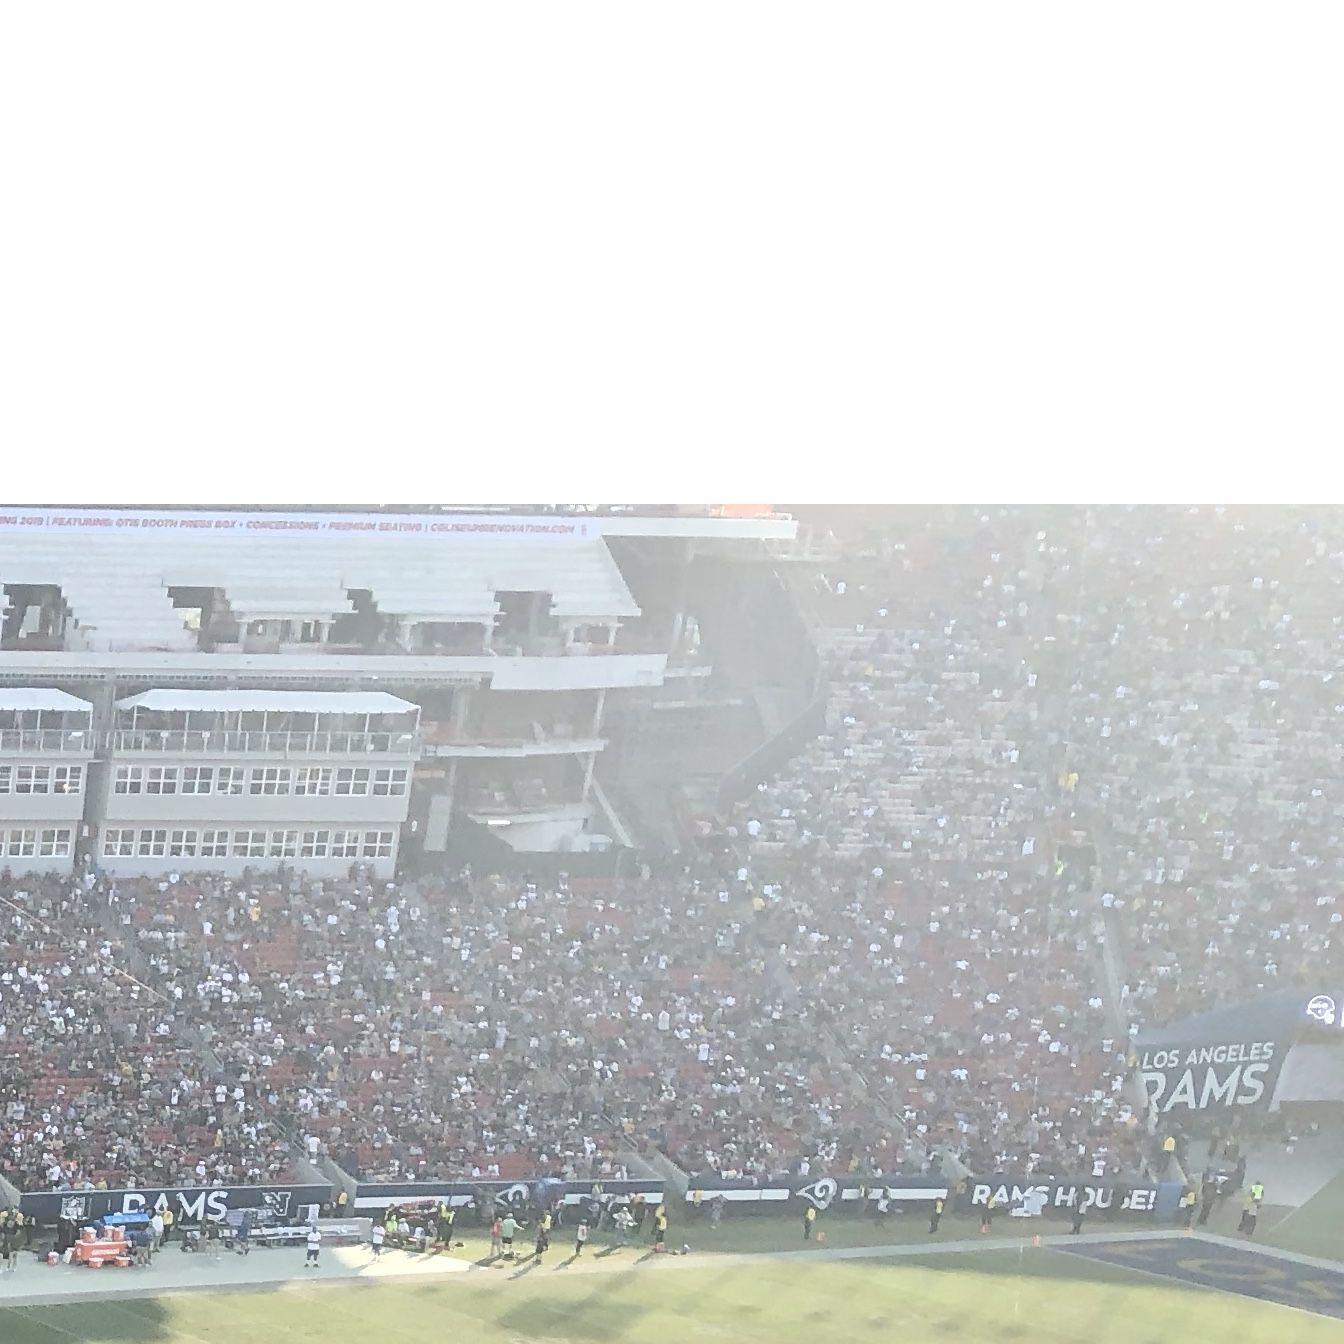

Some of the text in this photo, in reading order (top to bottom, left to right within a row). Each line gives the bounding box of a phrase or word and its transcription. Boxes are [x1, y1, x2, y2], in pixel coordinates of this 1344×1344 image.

[1142, 1042, 1274, 1069] LOS ANGELES
[1141, 1063, 1269, 1112] RAMS
